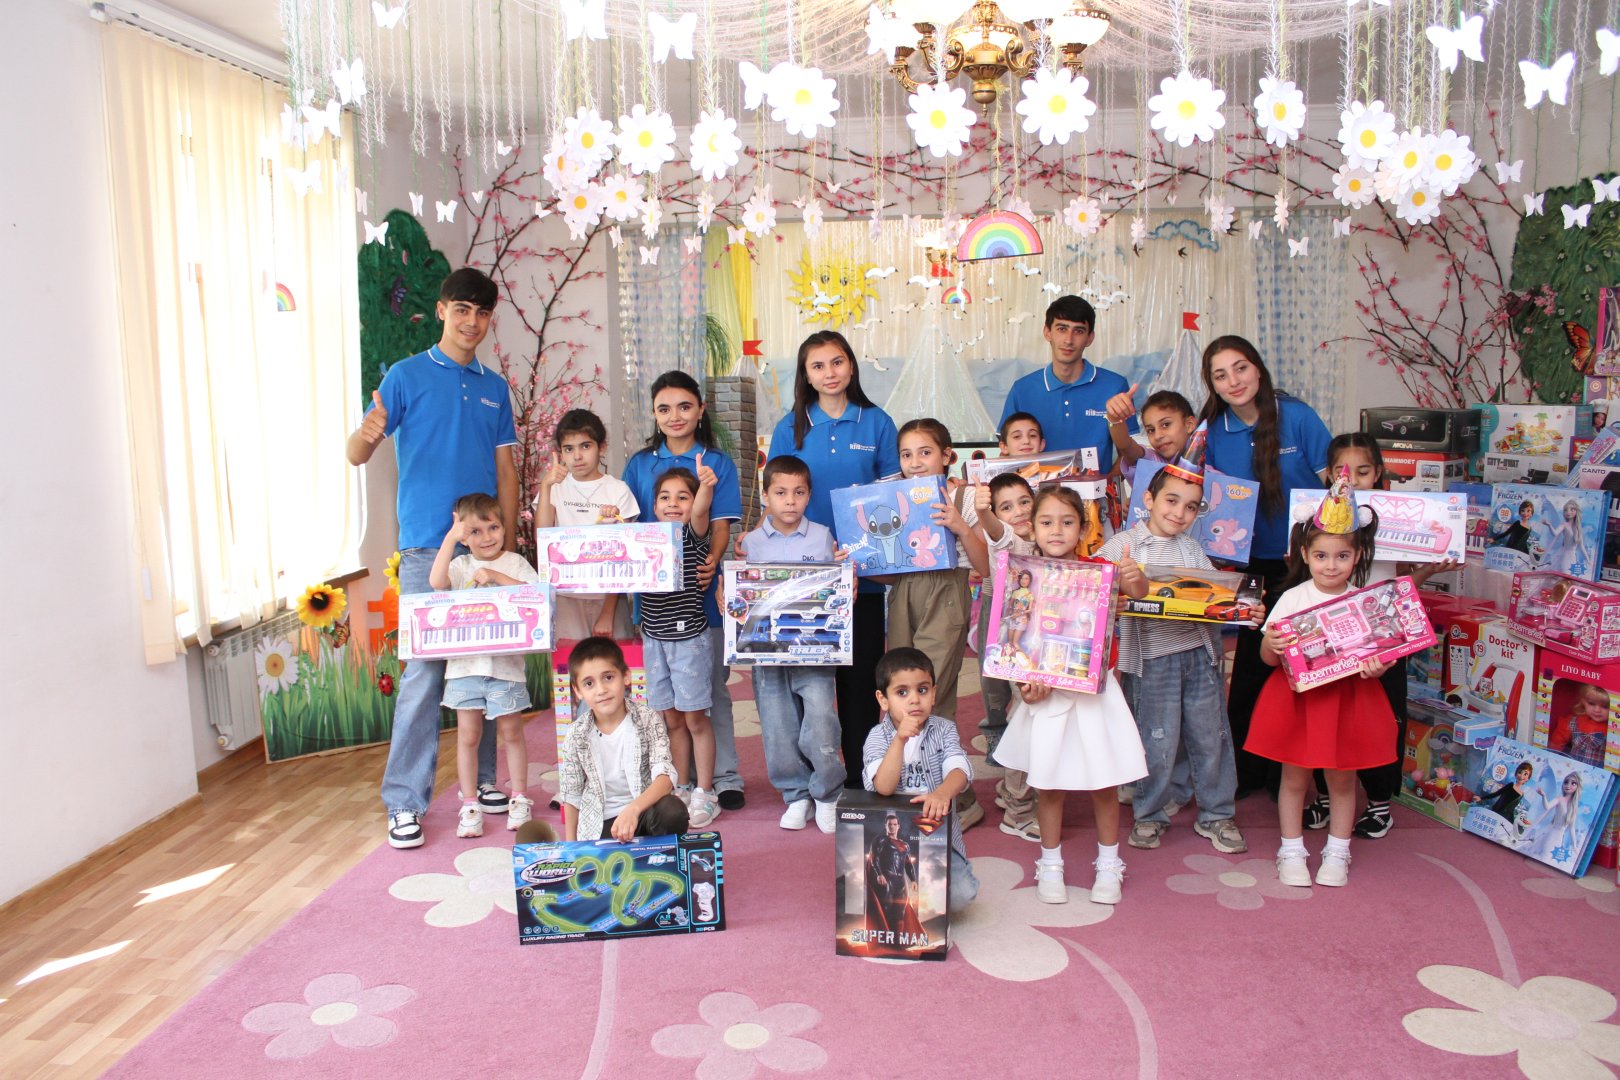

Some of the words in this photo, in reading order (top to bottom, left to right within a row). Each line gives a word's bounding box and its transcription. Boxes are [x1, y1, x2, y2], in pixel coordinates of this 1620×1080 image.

[1488, 635, 1528, 652] Doctor's
[1500, 648, 1514, 660] kit
[1300, 655, 1360, 684] Supermarket
[1561, 664, 1579, 675] LIYO
[1581, 669, 1601, 680] BABY
[1498, 746, 1524, 760] FROZEN
[528, 868, 576, 877] WORLD
[536, 862, 571, 870] RAPID
[852, 928, 895, 944] SUPER
[900, 932, 928, 946] MAN
